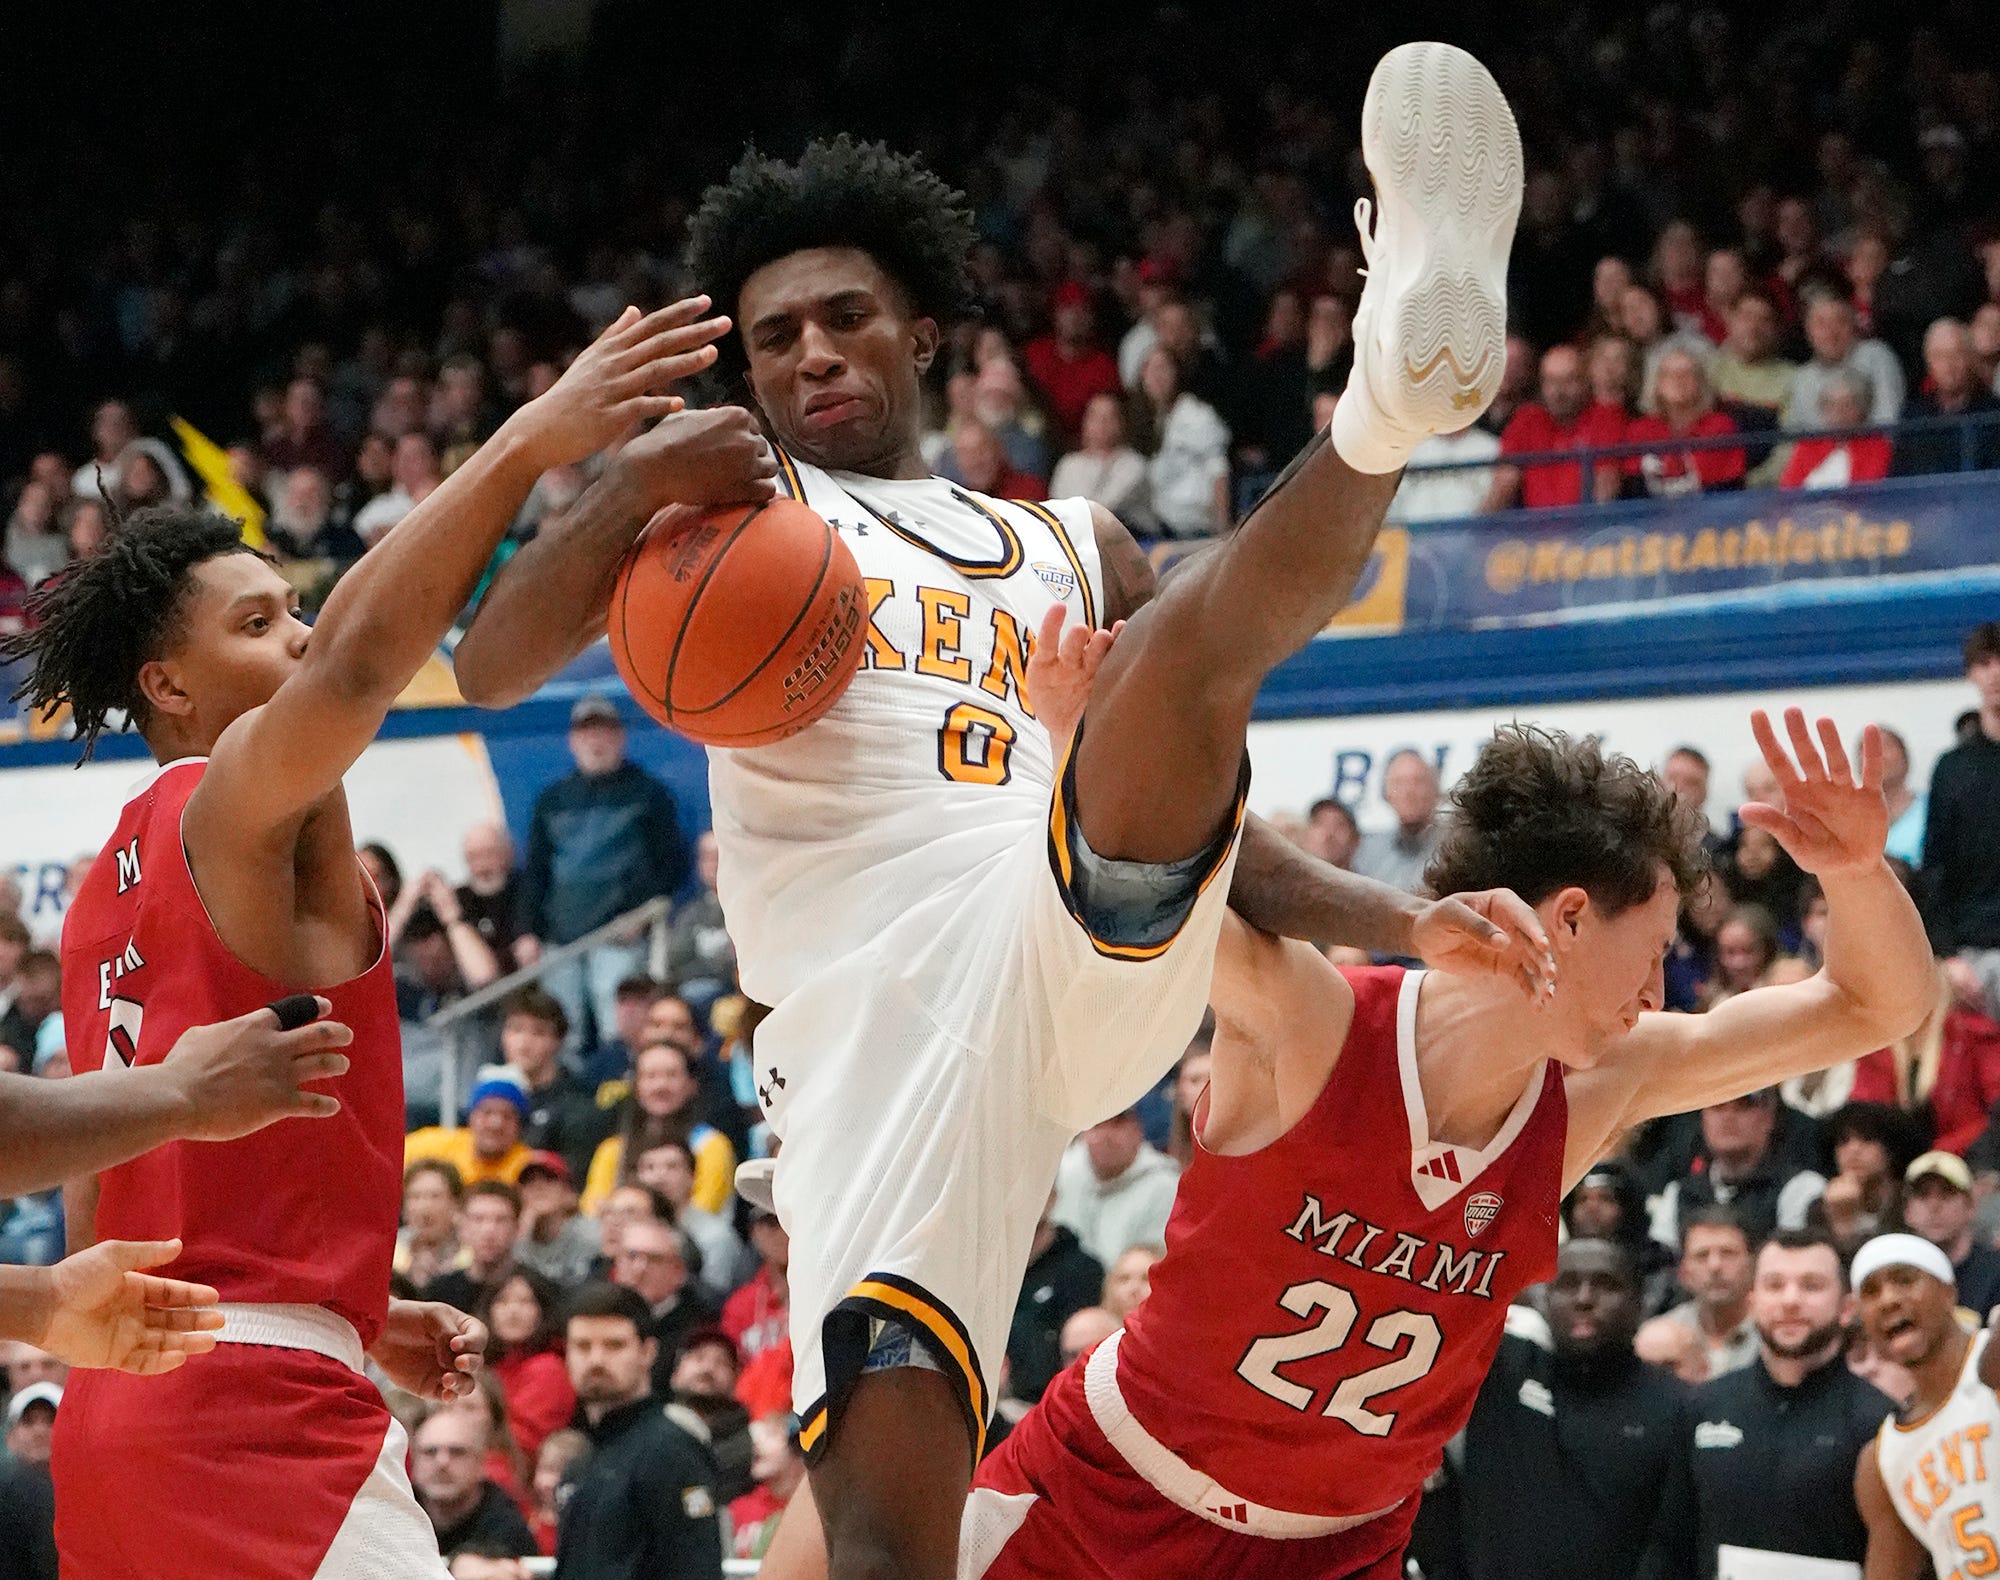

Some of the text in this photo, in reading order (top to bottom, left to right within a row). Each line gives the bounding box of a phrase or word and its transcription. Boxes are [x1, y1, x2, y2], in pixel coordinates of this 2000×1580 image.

[782, 585, 863, 713] LEGACY
[857, 576, 1038, 721] KEN
[937, 700, 1018, 786] 0
[1281, 1190, 1508, 1299] MIAMI
[1234, 1278, 1445, 1437] 22
[1902, 1423, 1991, 1525] KENT
[1951, 1502, 1999, 1577] 5
